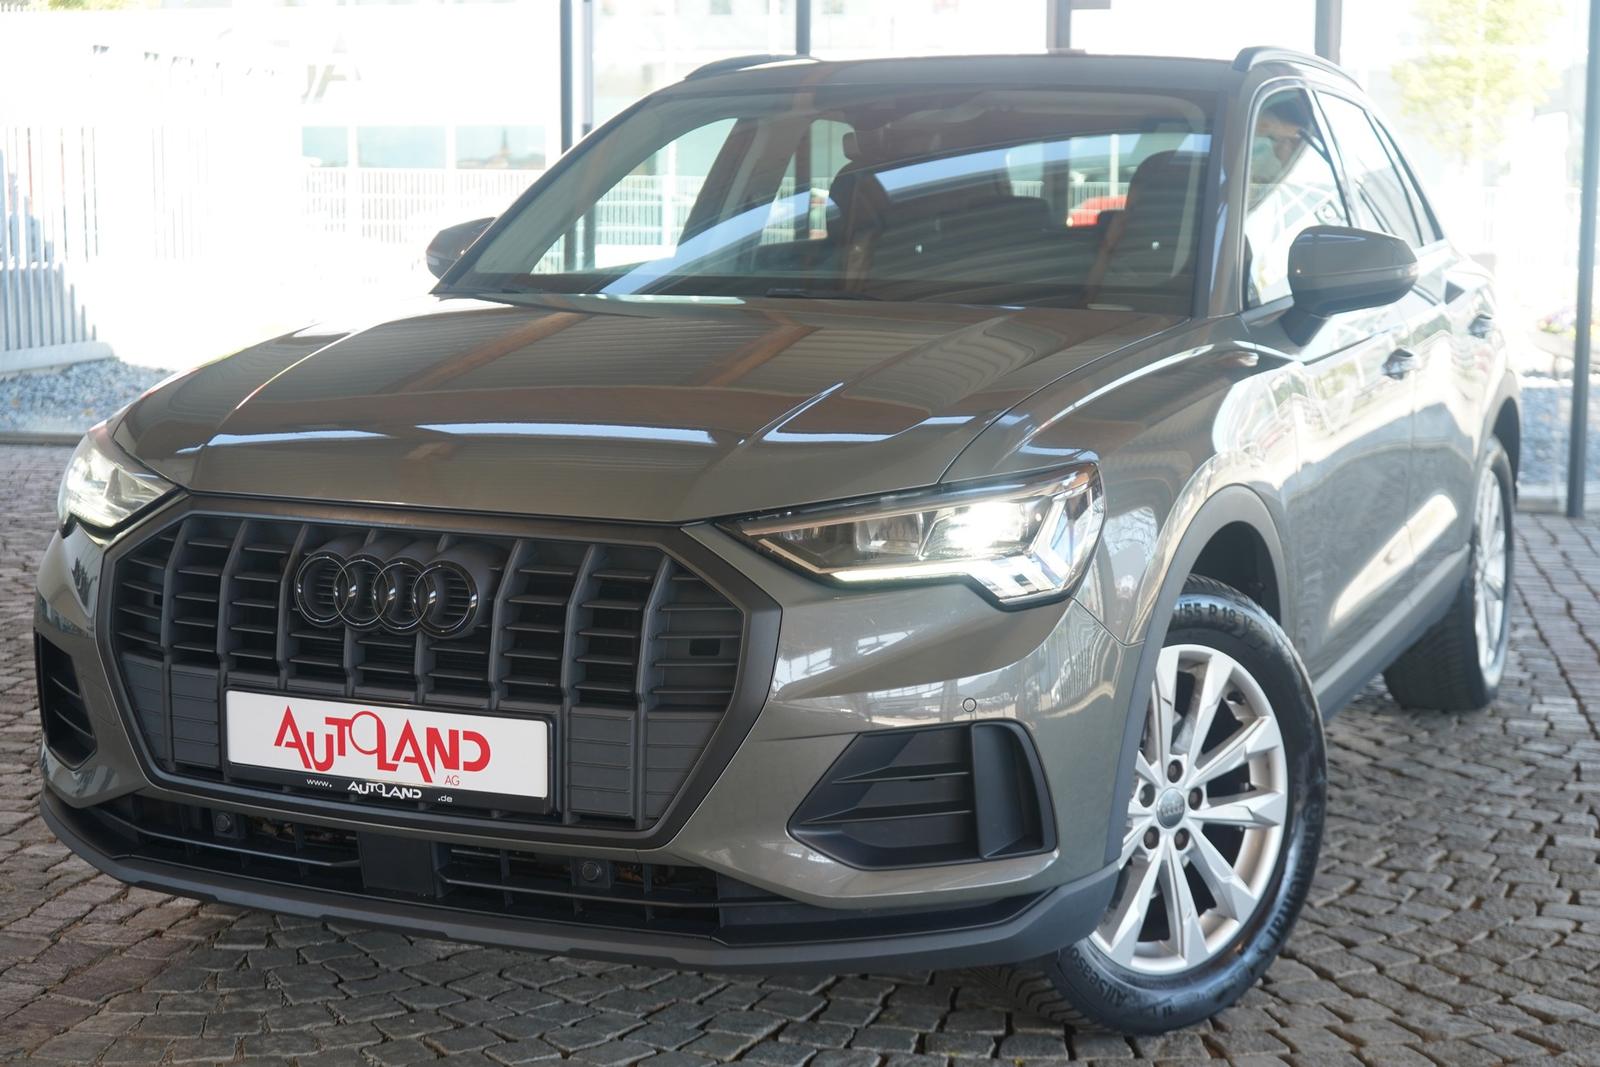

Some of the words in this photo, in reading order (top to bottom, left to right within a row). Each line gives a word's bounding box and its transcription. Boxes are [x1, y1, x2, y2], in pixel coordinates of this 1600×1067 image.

[274, 705, 491, 783] AUTOLAND
[306, 778, 333, 788] www.
[347, 781, 422, 799] AUTOLAND
[445, 774, 460, 786] AG
